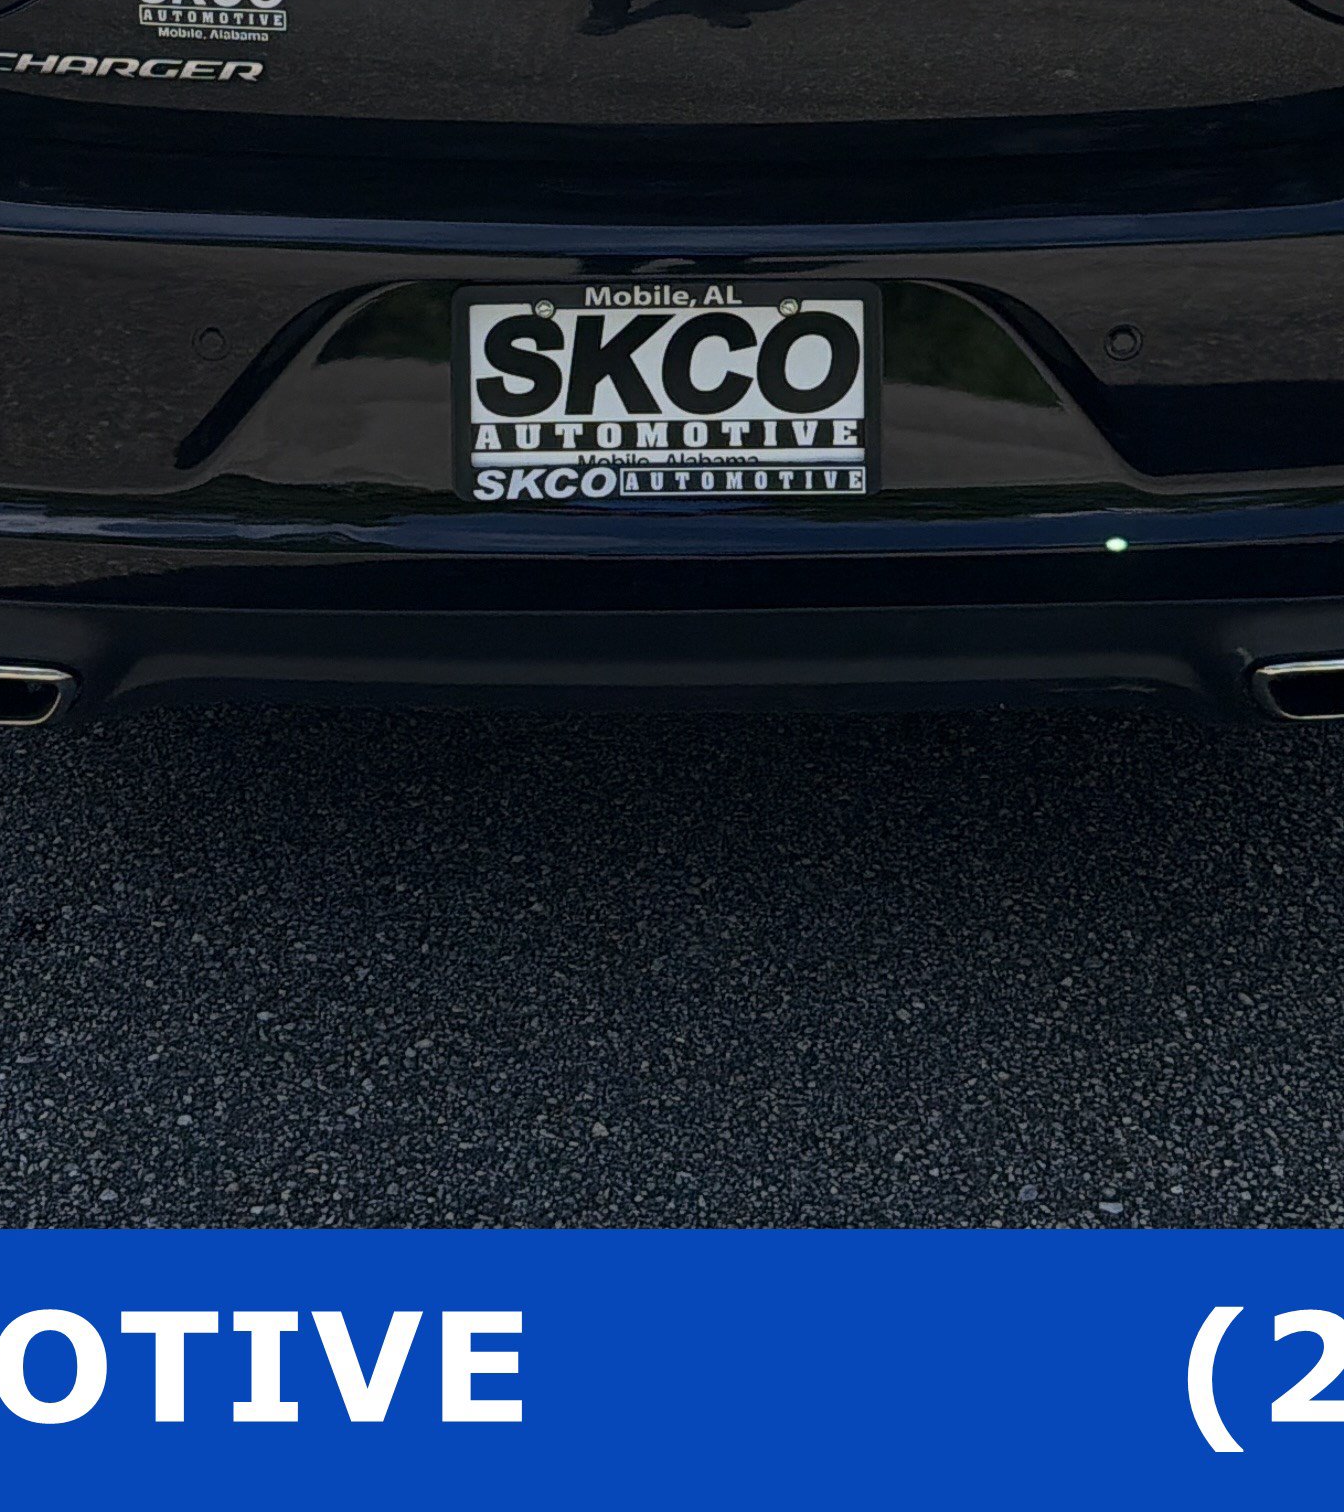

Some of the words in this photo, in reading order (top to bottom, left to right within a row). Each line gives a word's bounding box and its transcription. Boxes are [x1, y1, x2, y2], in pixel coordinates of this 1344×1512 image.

[143, 8, 283, 27] AUTOMOTIVE
[158, 27, 207, 40] Mobile,
[209, 29, 269, 42] Alabama
[584, 285, 696, 309] Mobile,
[703, 285, 743, 306] AL
[475, 310, 861, 418] SKCO
[474, 419, 858, 450] AUTOMOTIVE
[473, 466, 617, 501] SKCO
[624, 470, 863, 492] AUTOMOTIVE
